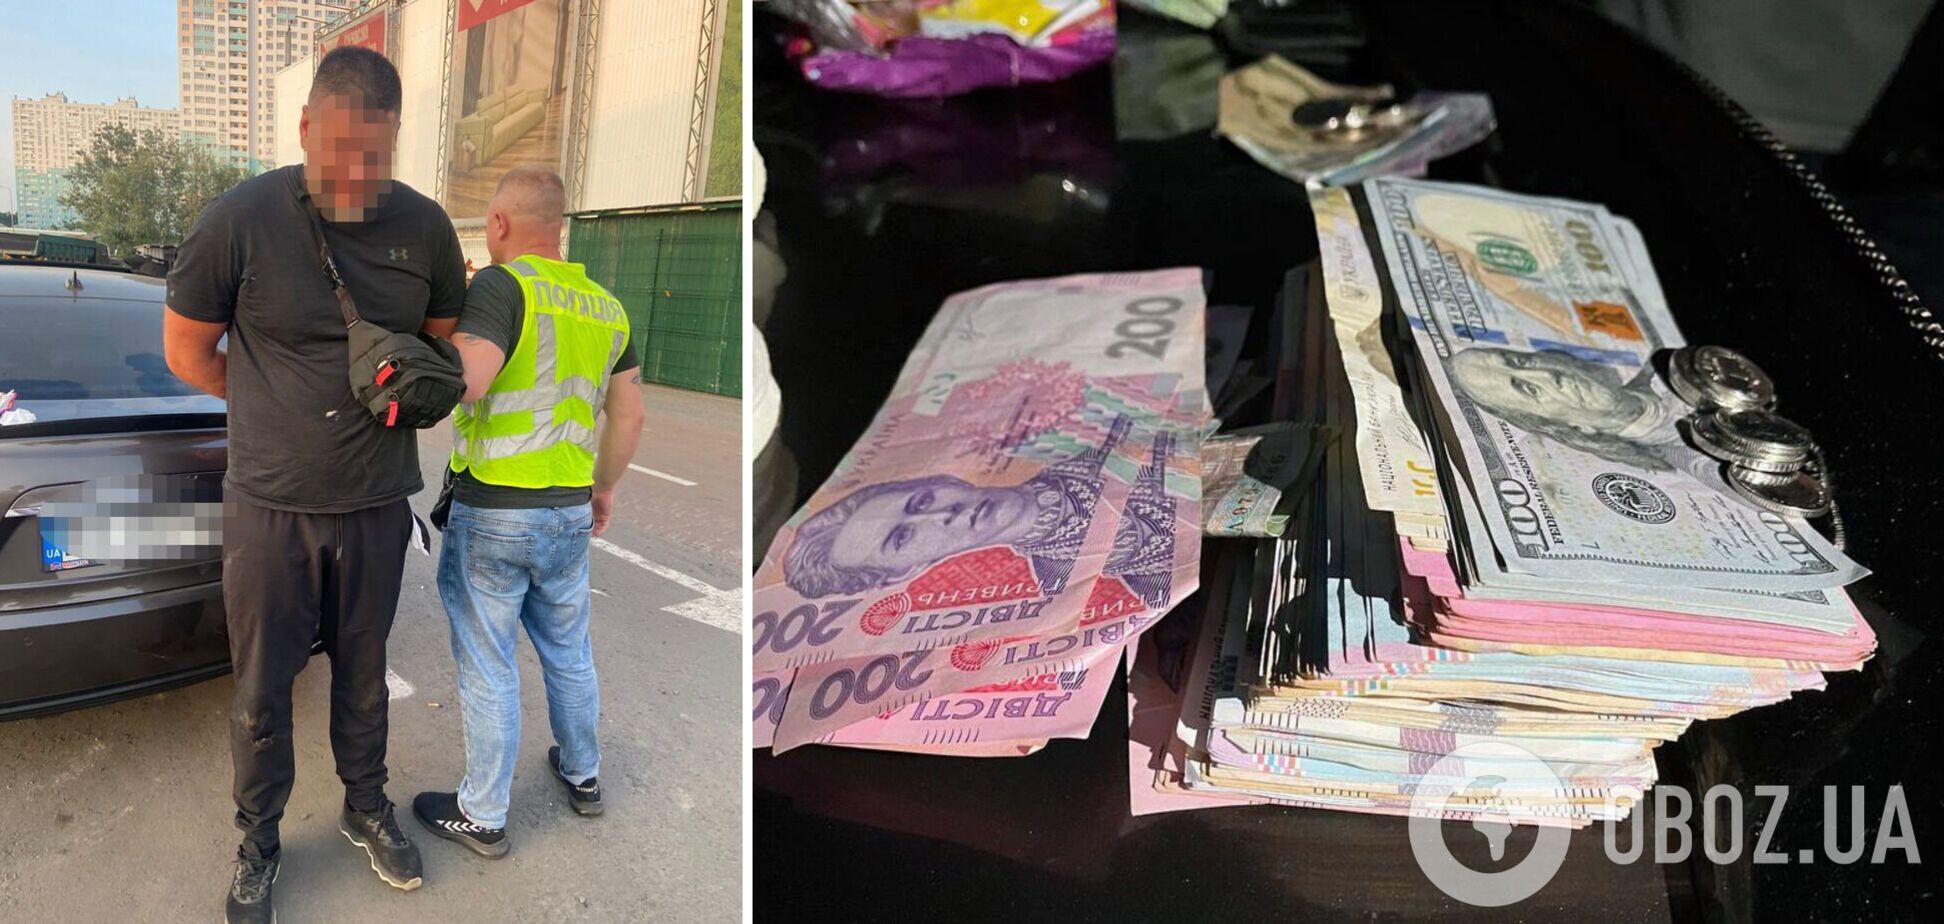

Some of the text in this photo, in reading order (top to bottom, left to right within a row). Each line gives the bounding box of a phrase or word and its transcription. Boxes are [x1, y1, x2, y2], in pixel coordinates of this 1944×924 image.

[1566, 220, 1611, 274] 100
[1104, 296, 1184, 361] 200
[1512, 447, 1538, 491] RESERVE
[1500, 478, 1550, 552] 100
[1534, 493, 1565, 545] FEDERAL
[46, 549, 61, 559] UA
[902, 597, 1054, 634] ДВІСТІ
[918, 578, 1063, 605] ГРИВЕНЬ
[809, 650, 935, 721] 200
[910, 692, 1072, 721] ДВІСТІ
